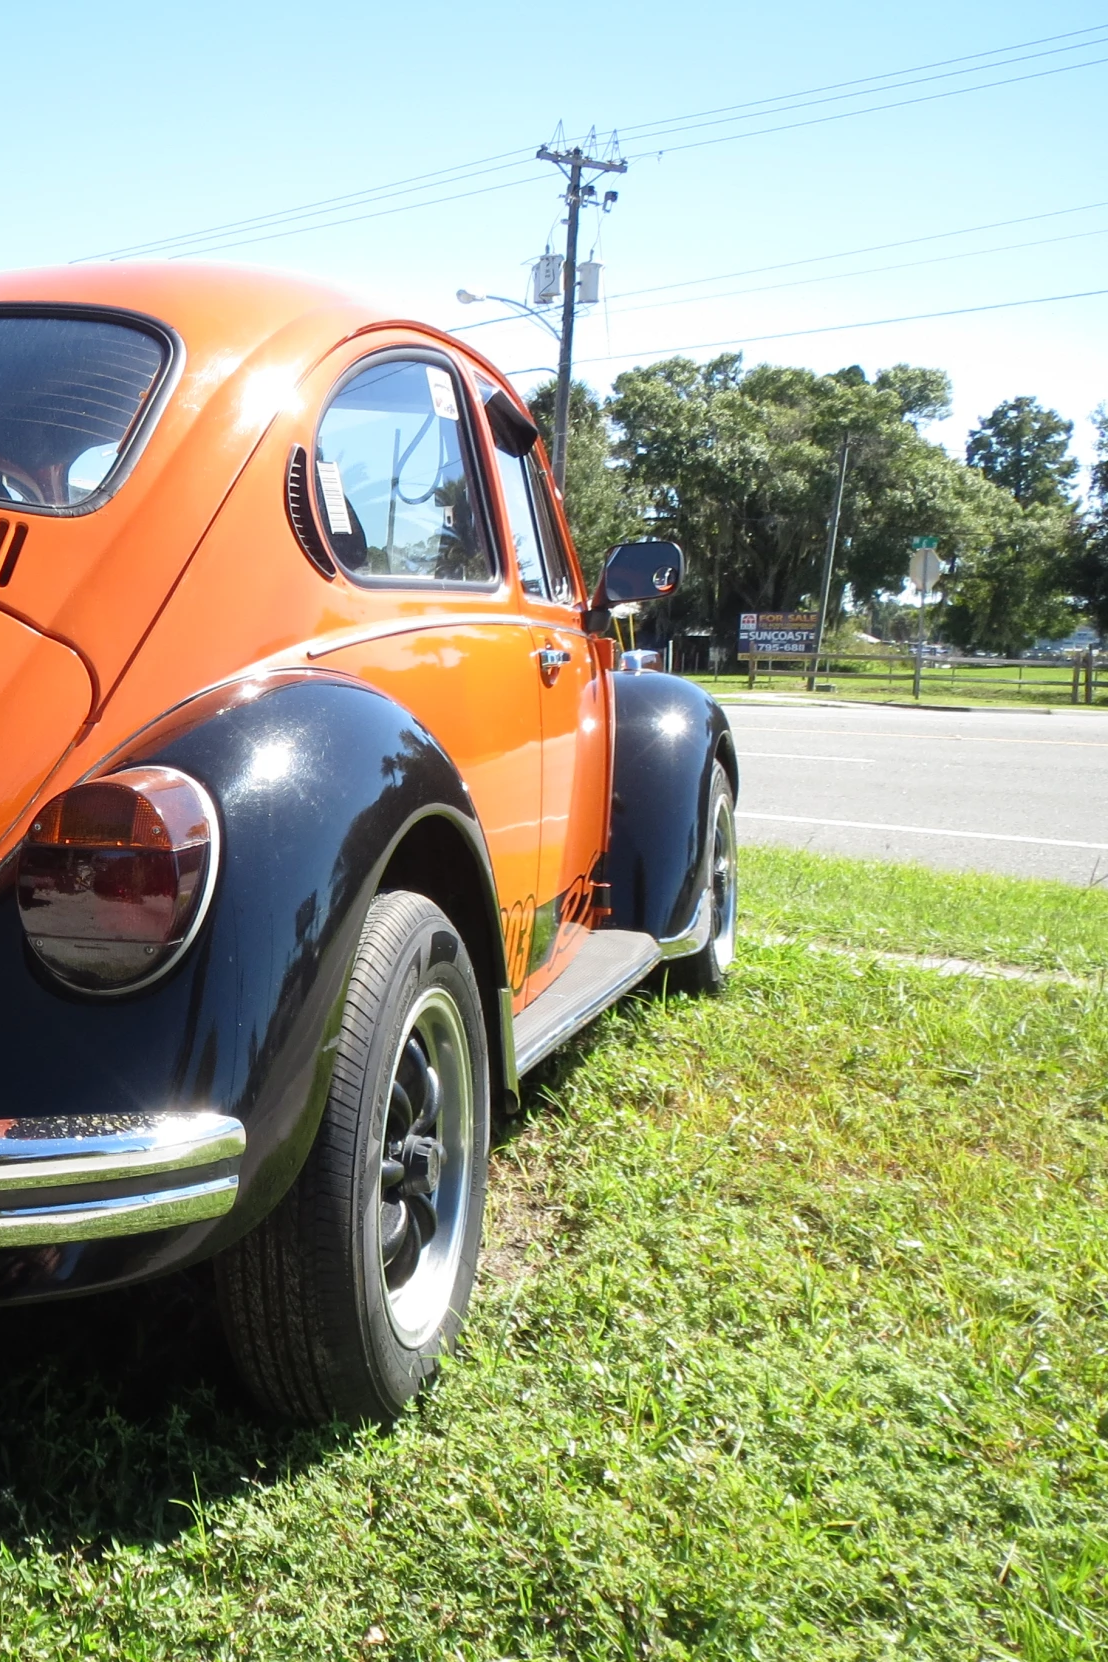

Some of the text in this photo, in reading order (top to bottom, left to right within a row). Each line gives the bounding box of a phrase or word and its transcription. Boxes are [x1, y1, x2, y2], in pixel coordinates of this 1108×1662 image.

[758, 614, 818, 623] FOR SALE
[748, 631, 809, 641] SUNCOAST
